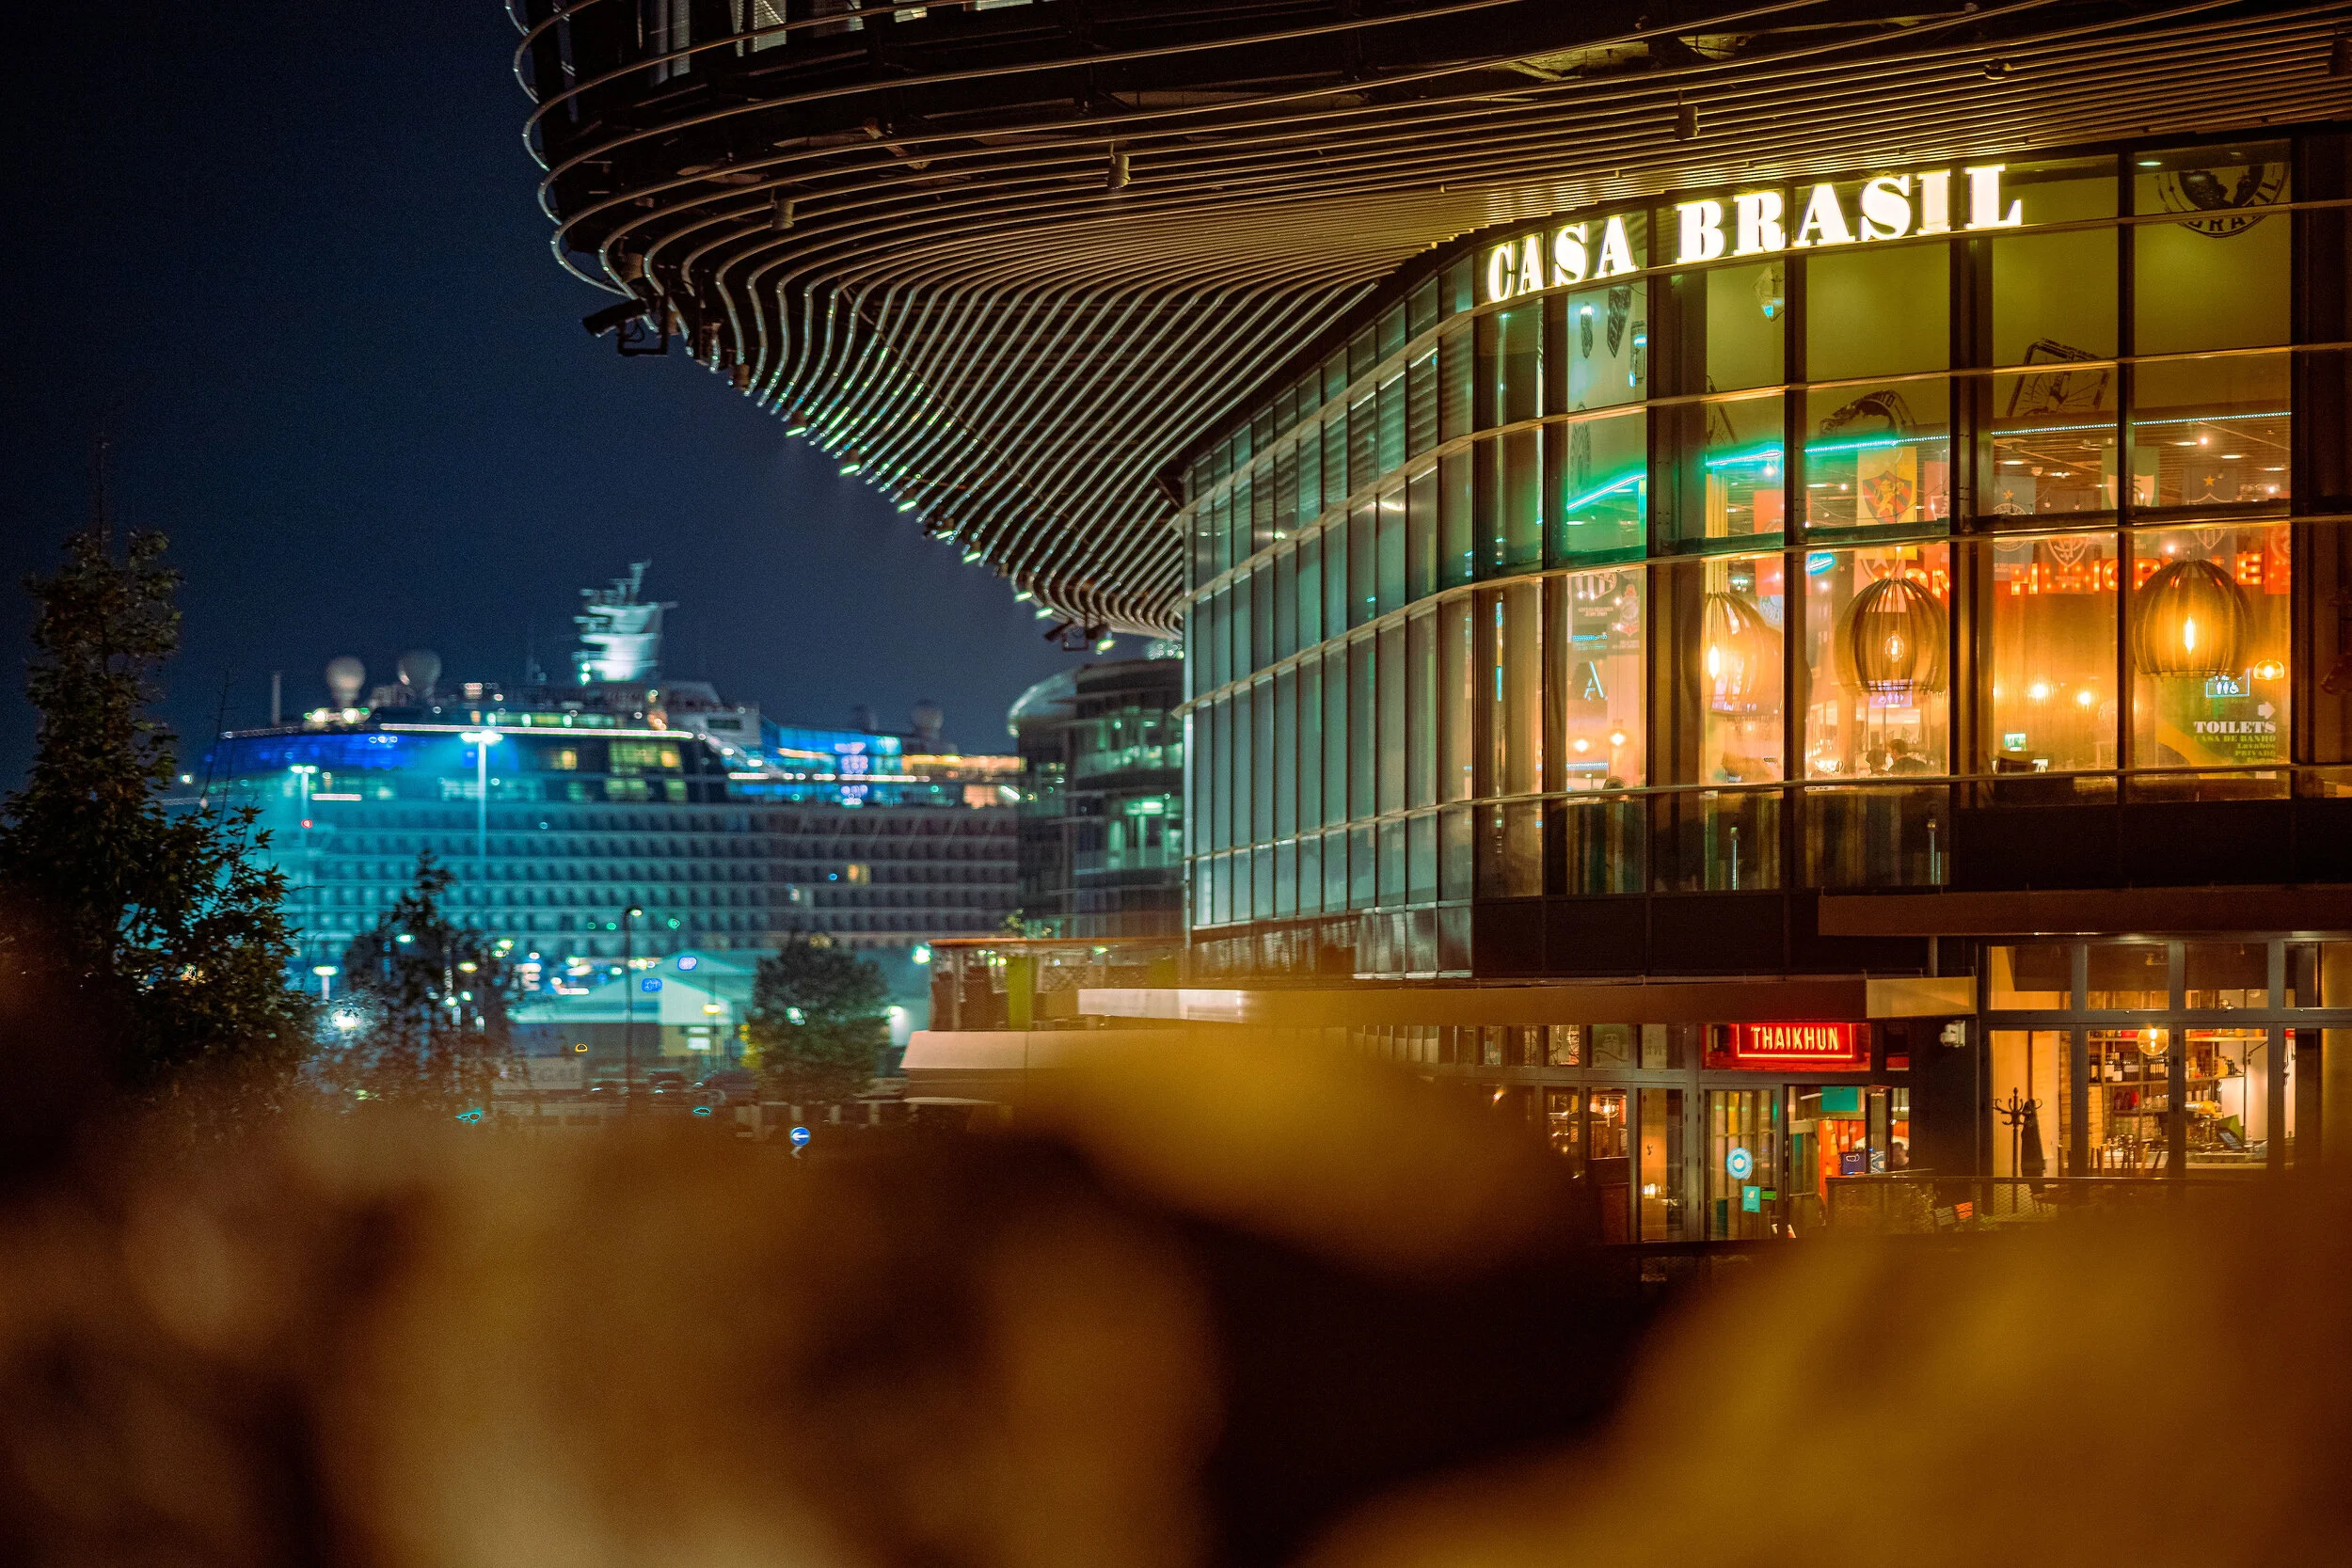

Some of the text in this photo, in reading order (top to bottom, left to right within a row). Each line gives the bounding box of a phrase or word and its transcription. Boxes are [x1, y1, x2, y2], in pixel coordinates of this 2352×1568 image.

[1487, 164, 2023, 303] CASA BRASIL
[2194, 721, 2277, 734] TOILETS
[1751, 1026, 1839, 1051] THAIKHUN
